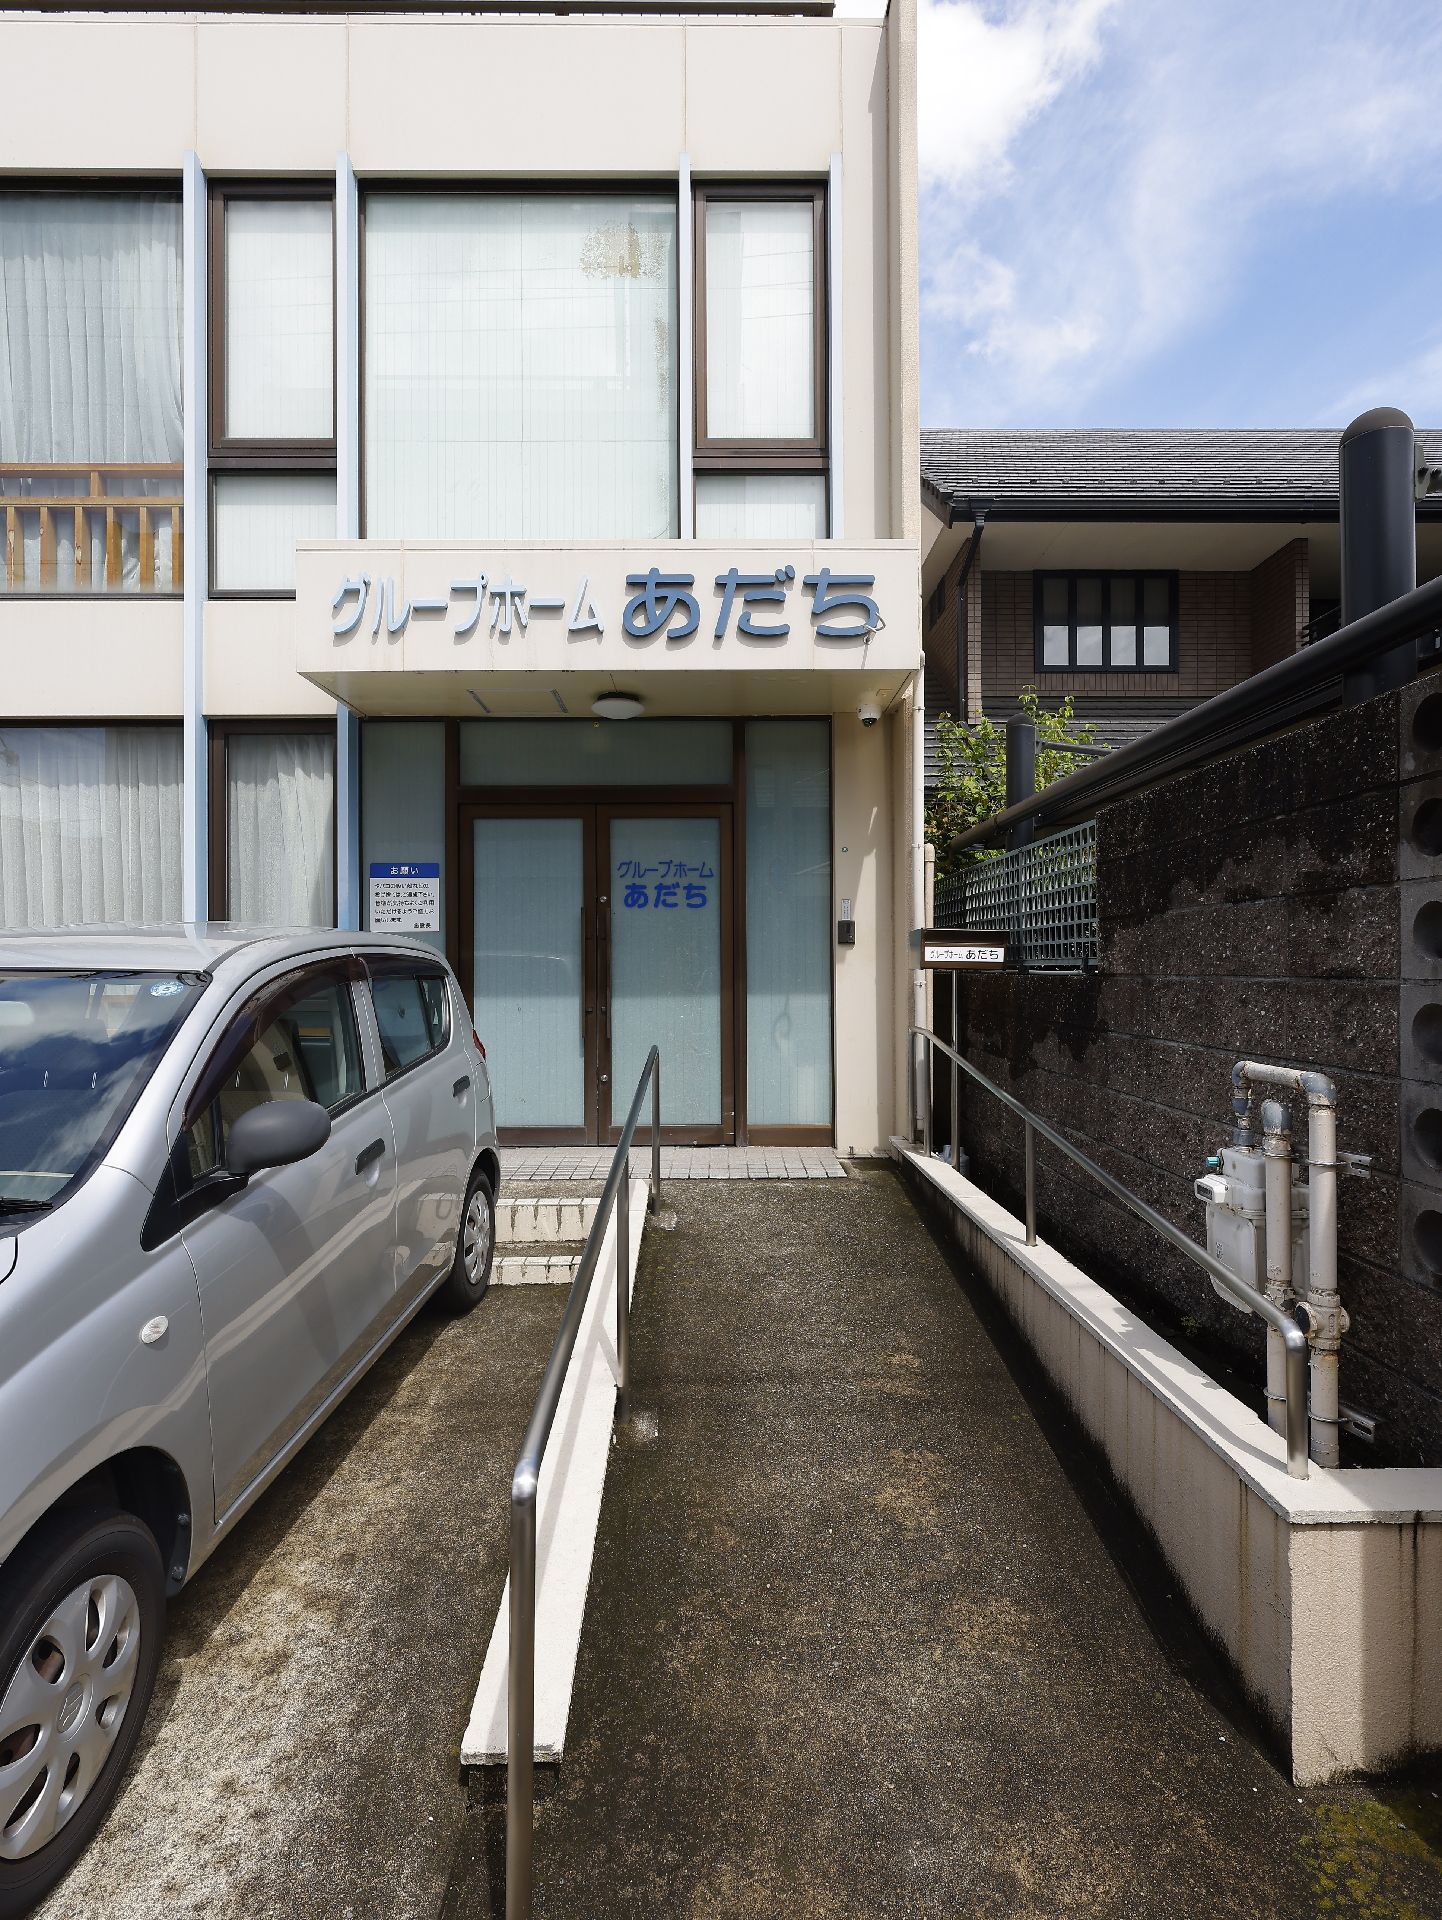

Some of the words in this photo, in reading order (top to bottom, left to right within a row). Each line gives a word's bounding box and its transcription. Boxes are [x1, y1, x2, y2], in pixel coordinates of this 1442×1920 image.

[331, 570, 605, 636] グループホーム
[621, 565, 880, 639] あだち
[390, 867, 419, 875] お願い
[616, 859, 714, 878] グループホーム
[623, 881, 708, 909] あだち
[965, 949, 999, 960] あだち
